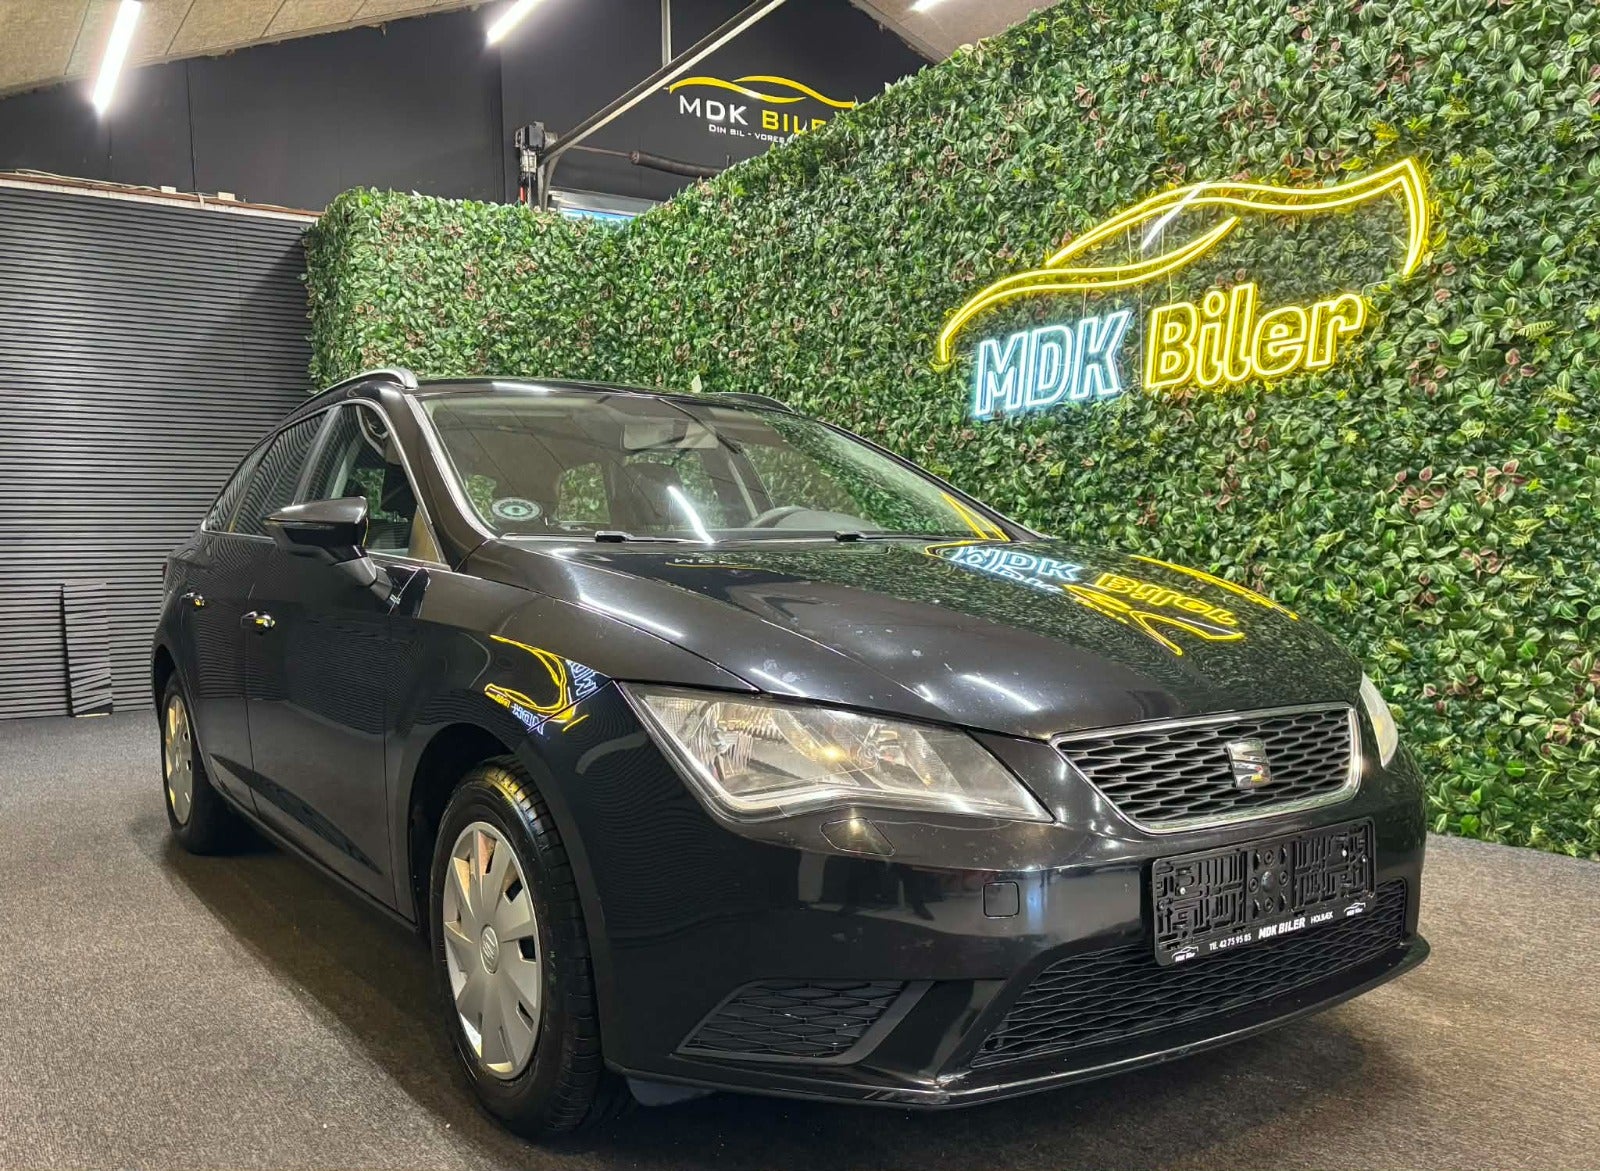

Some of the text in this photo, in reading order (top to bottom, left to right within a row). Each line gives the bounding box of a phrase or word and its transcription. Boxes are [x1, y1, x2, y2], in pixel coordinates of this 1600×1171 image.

[679, 94, 748, 126] MDK
[729, 128, 745, 137] BIL
[975, 283, 1366, 416] MDK Biler
[1258, 924, 1278, 939] MDK
[1278, 917, 1306, 934] BILER
